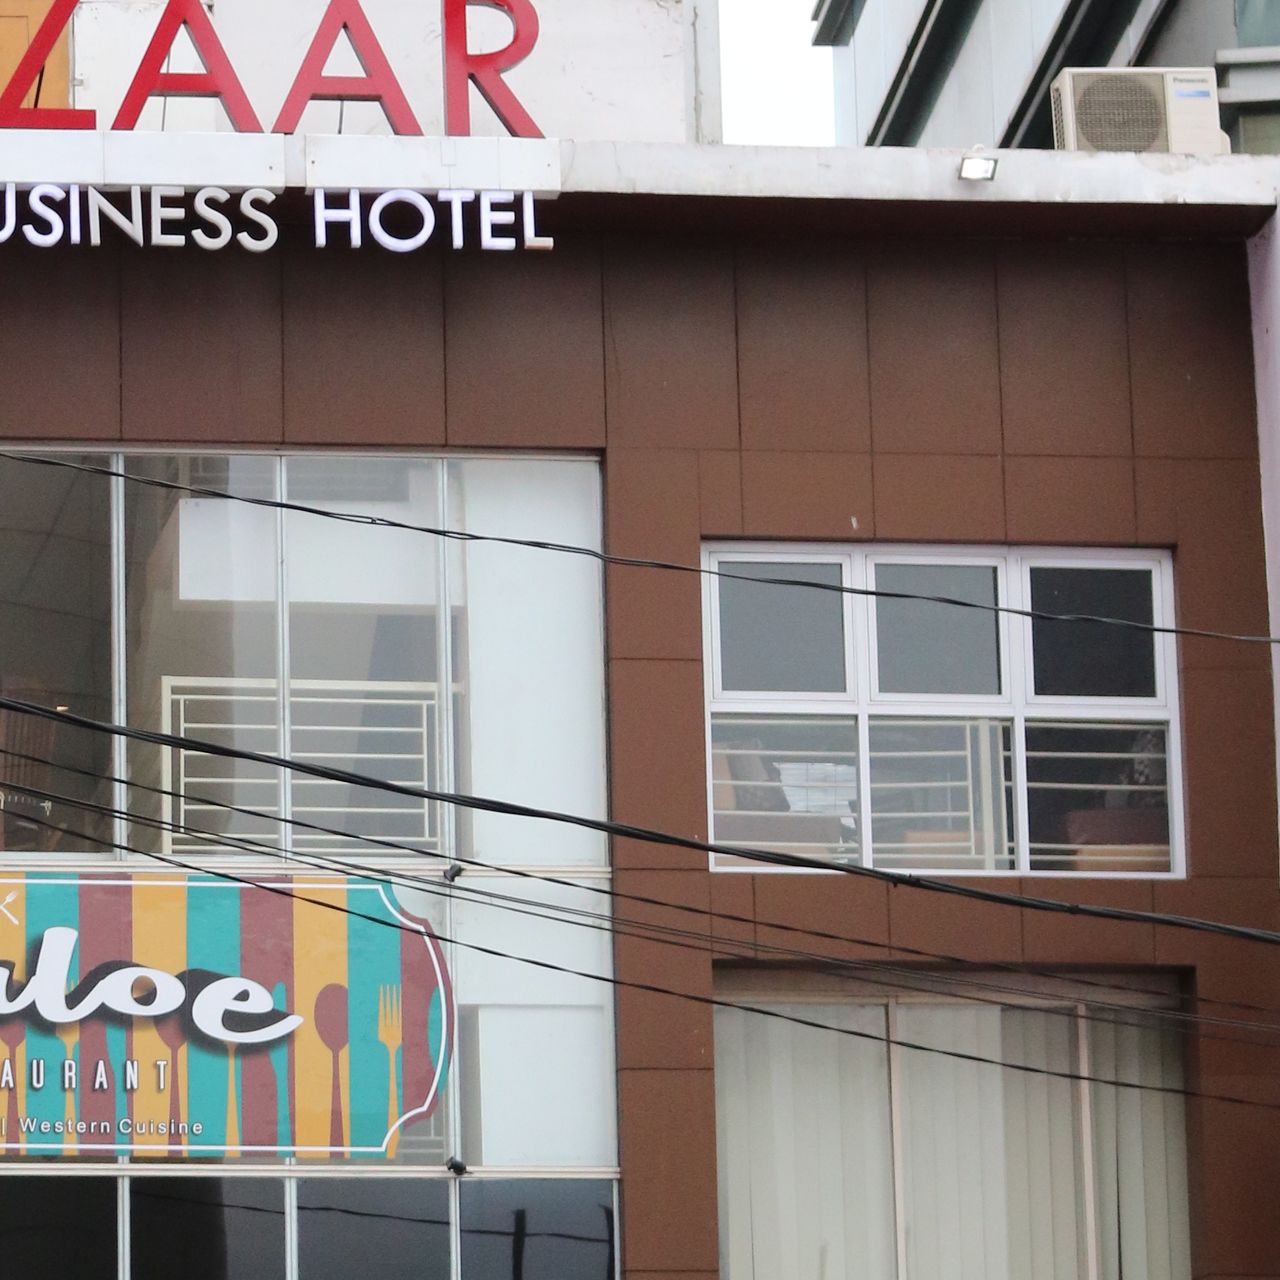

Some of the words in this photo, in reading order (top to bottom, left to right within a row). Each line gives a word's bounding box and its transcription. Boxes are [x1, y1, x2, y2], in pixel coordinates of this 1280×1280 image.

[314, 188, 555, 252] HOTEL
[18, 1117, 112, 1137] Western
[118, 1117, 204, 1138] Cuisine
